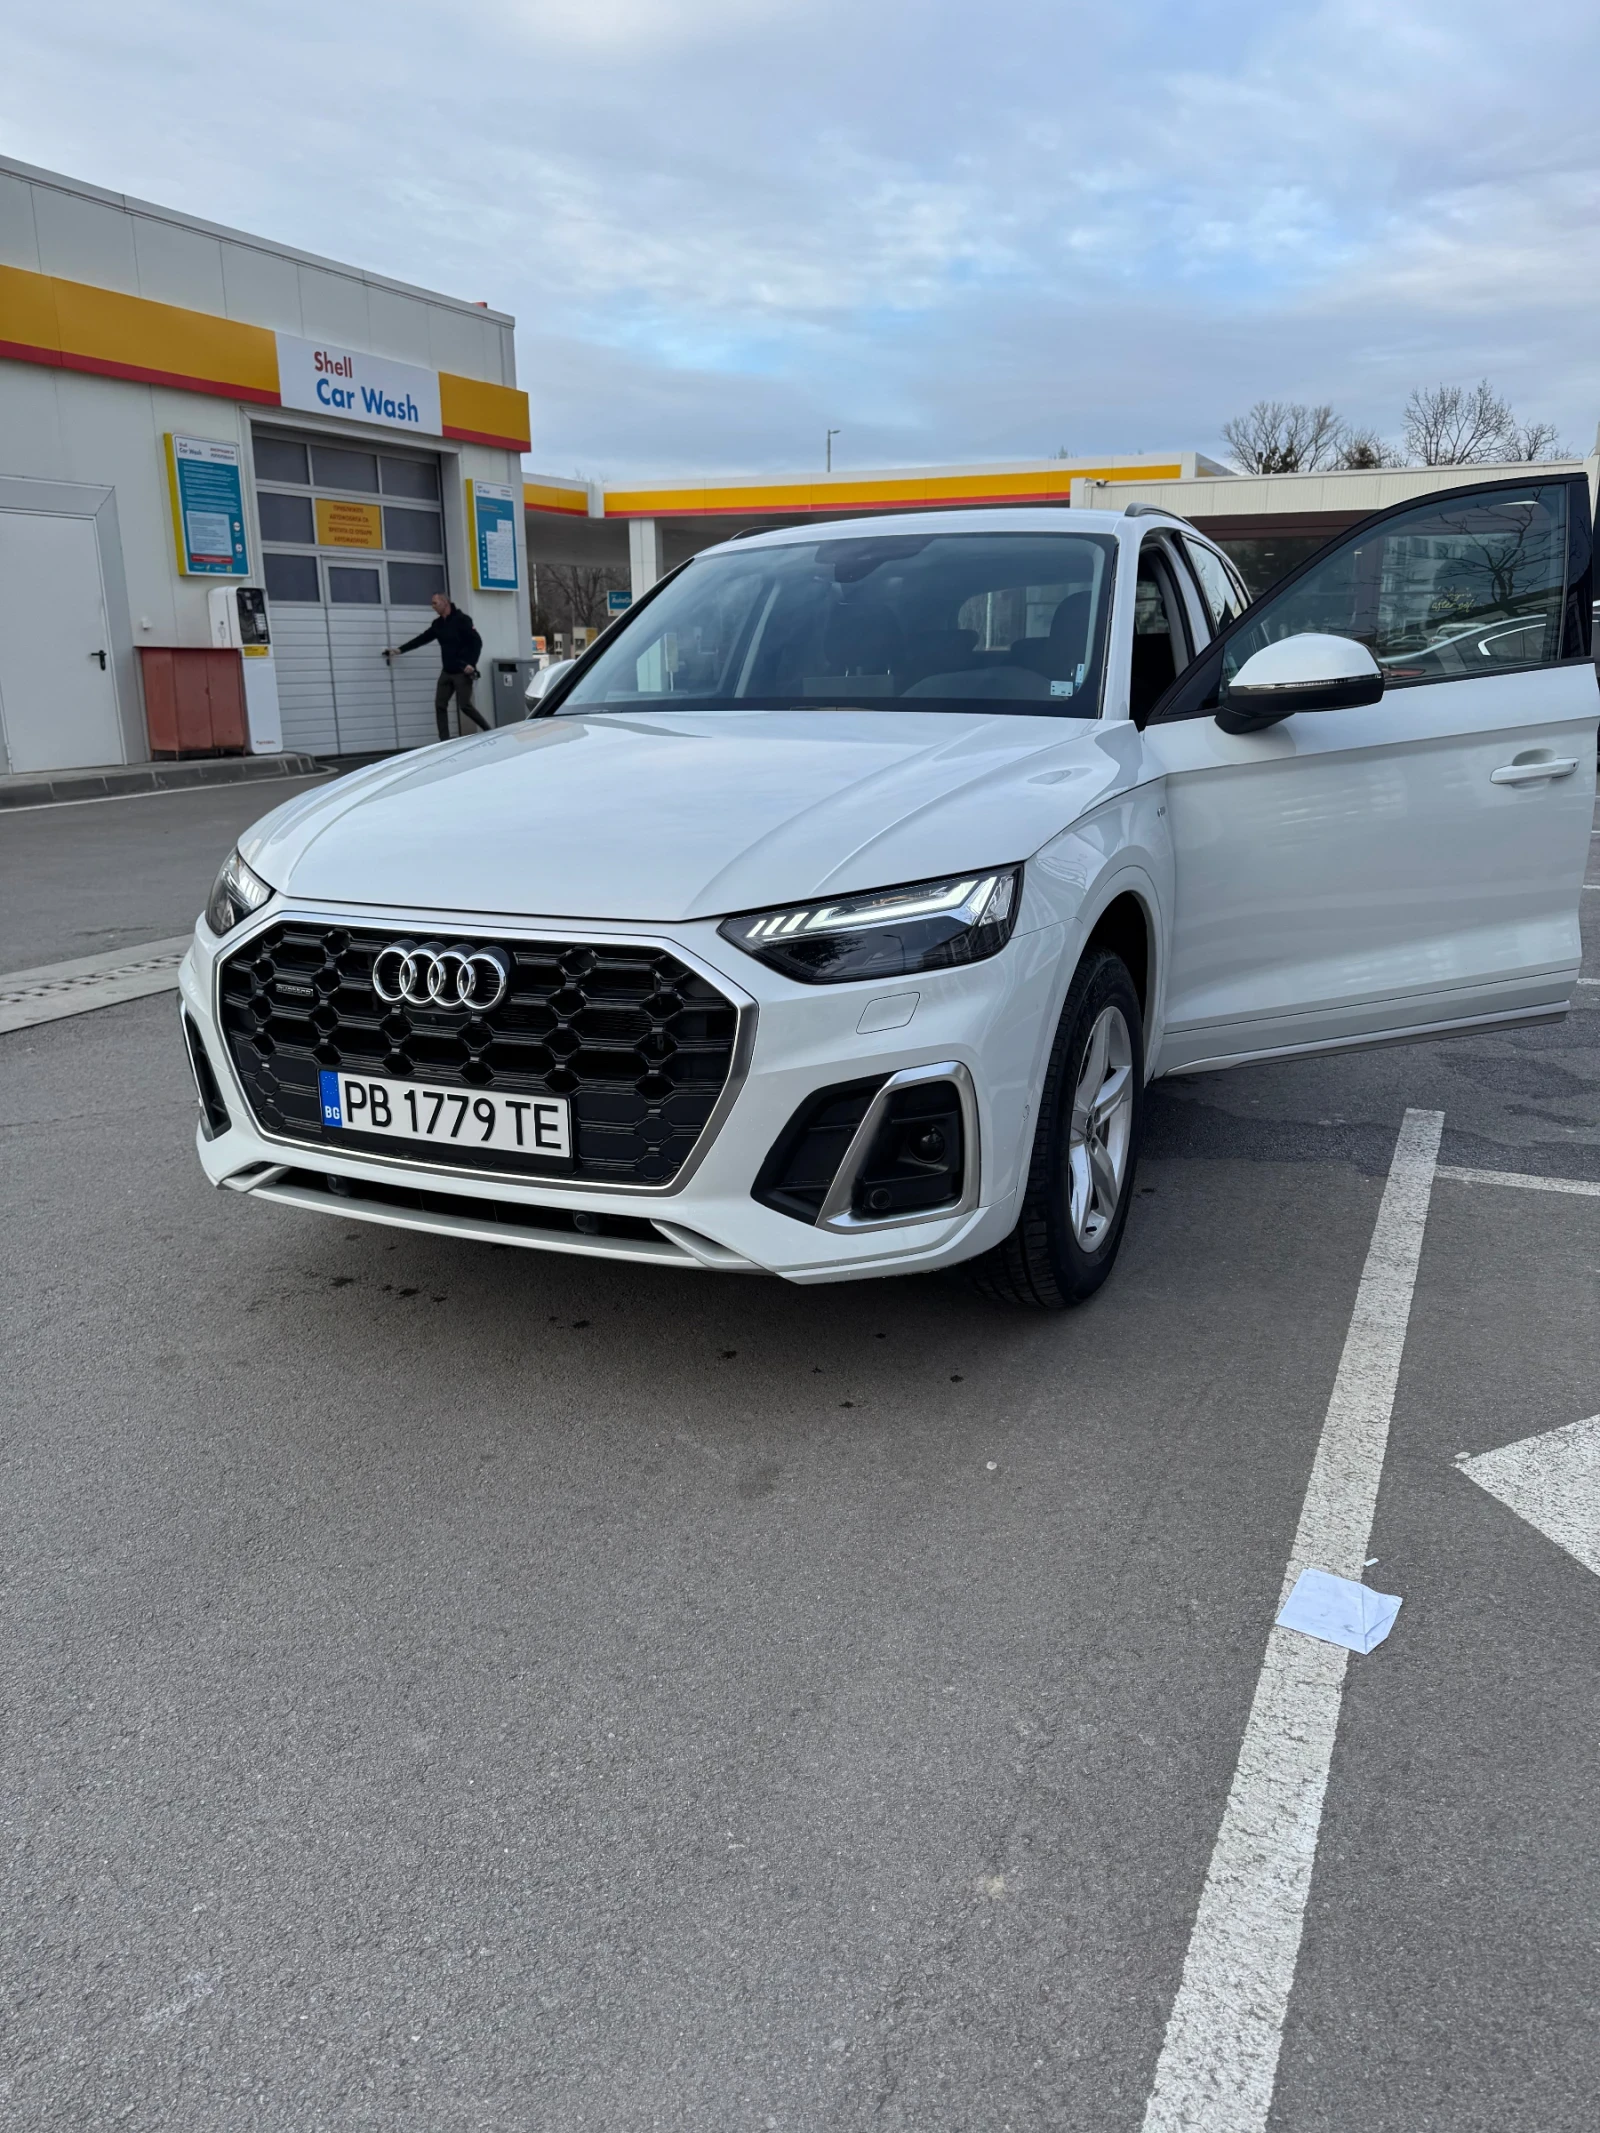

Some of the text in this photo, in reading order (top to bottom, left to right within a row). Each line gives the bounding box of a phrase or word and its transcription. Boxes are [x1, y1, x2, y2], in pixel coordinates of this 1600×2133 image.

[314, 351, 353, 378] Shell
[316, 378, 419, 422] Car Wash
[324, 1105, 340, 1119] BG
[344, 1080, 562, 1149] PB 1779 TE
